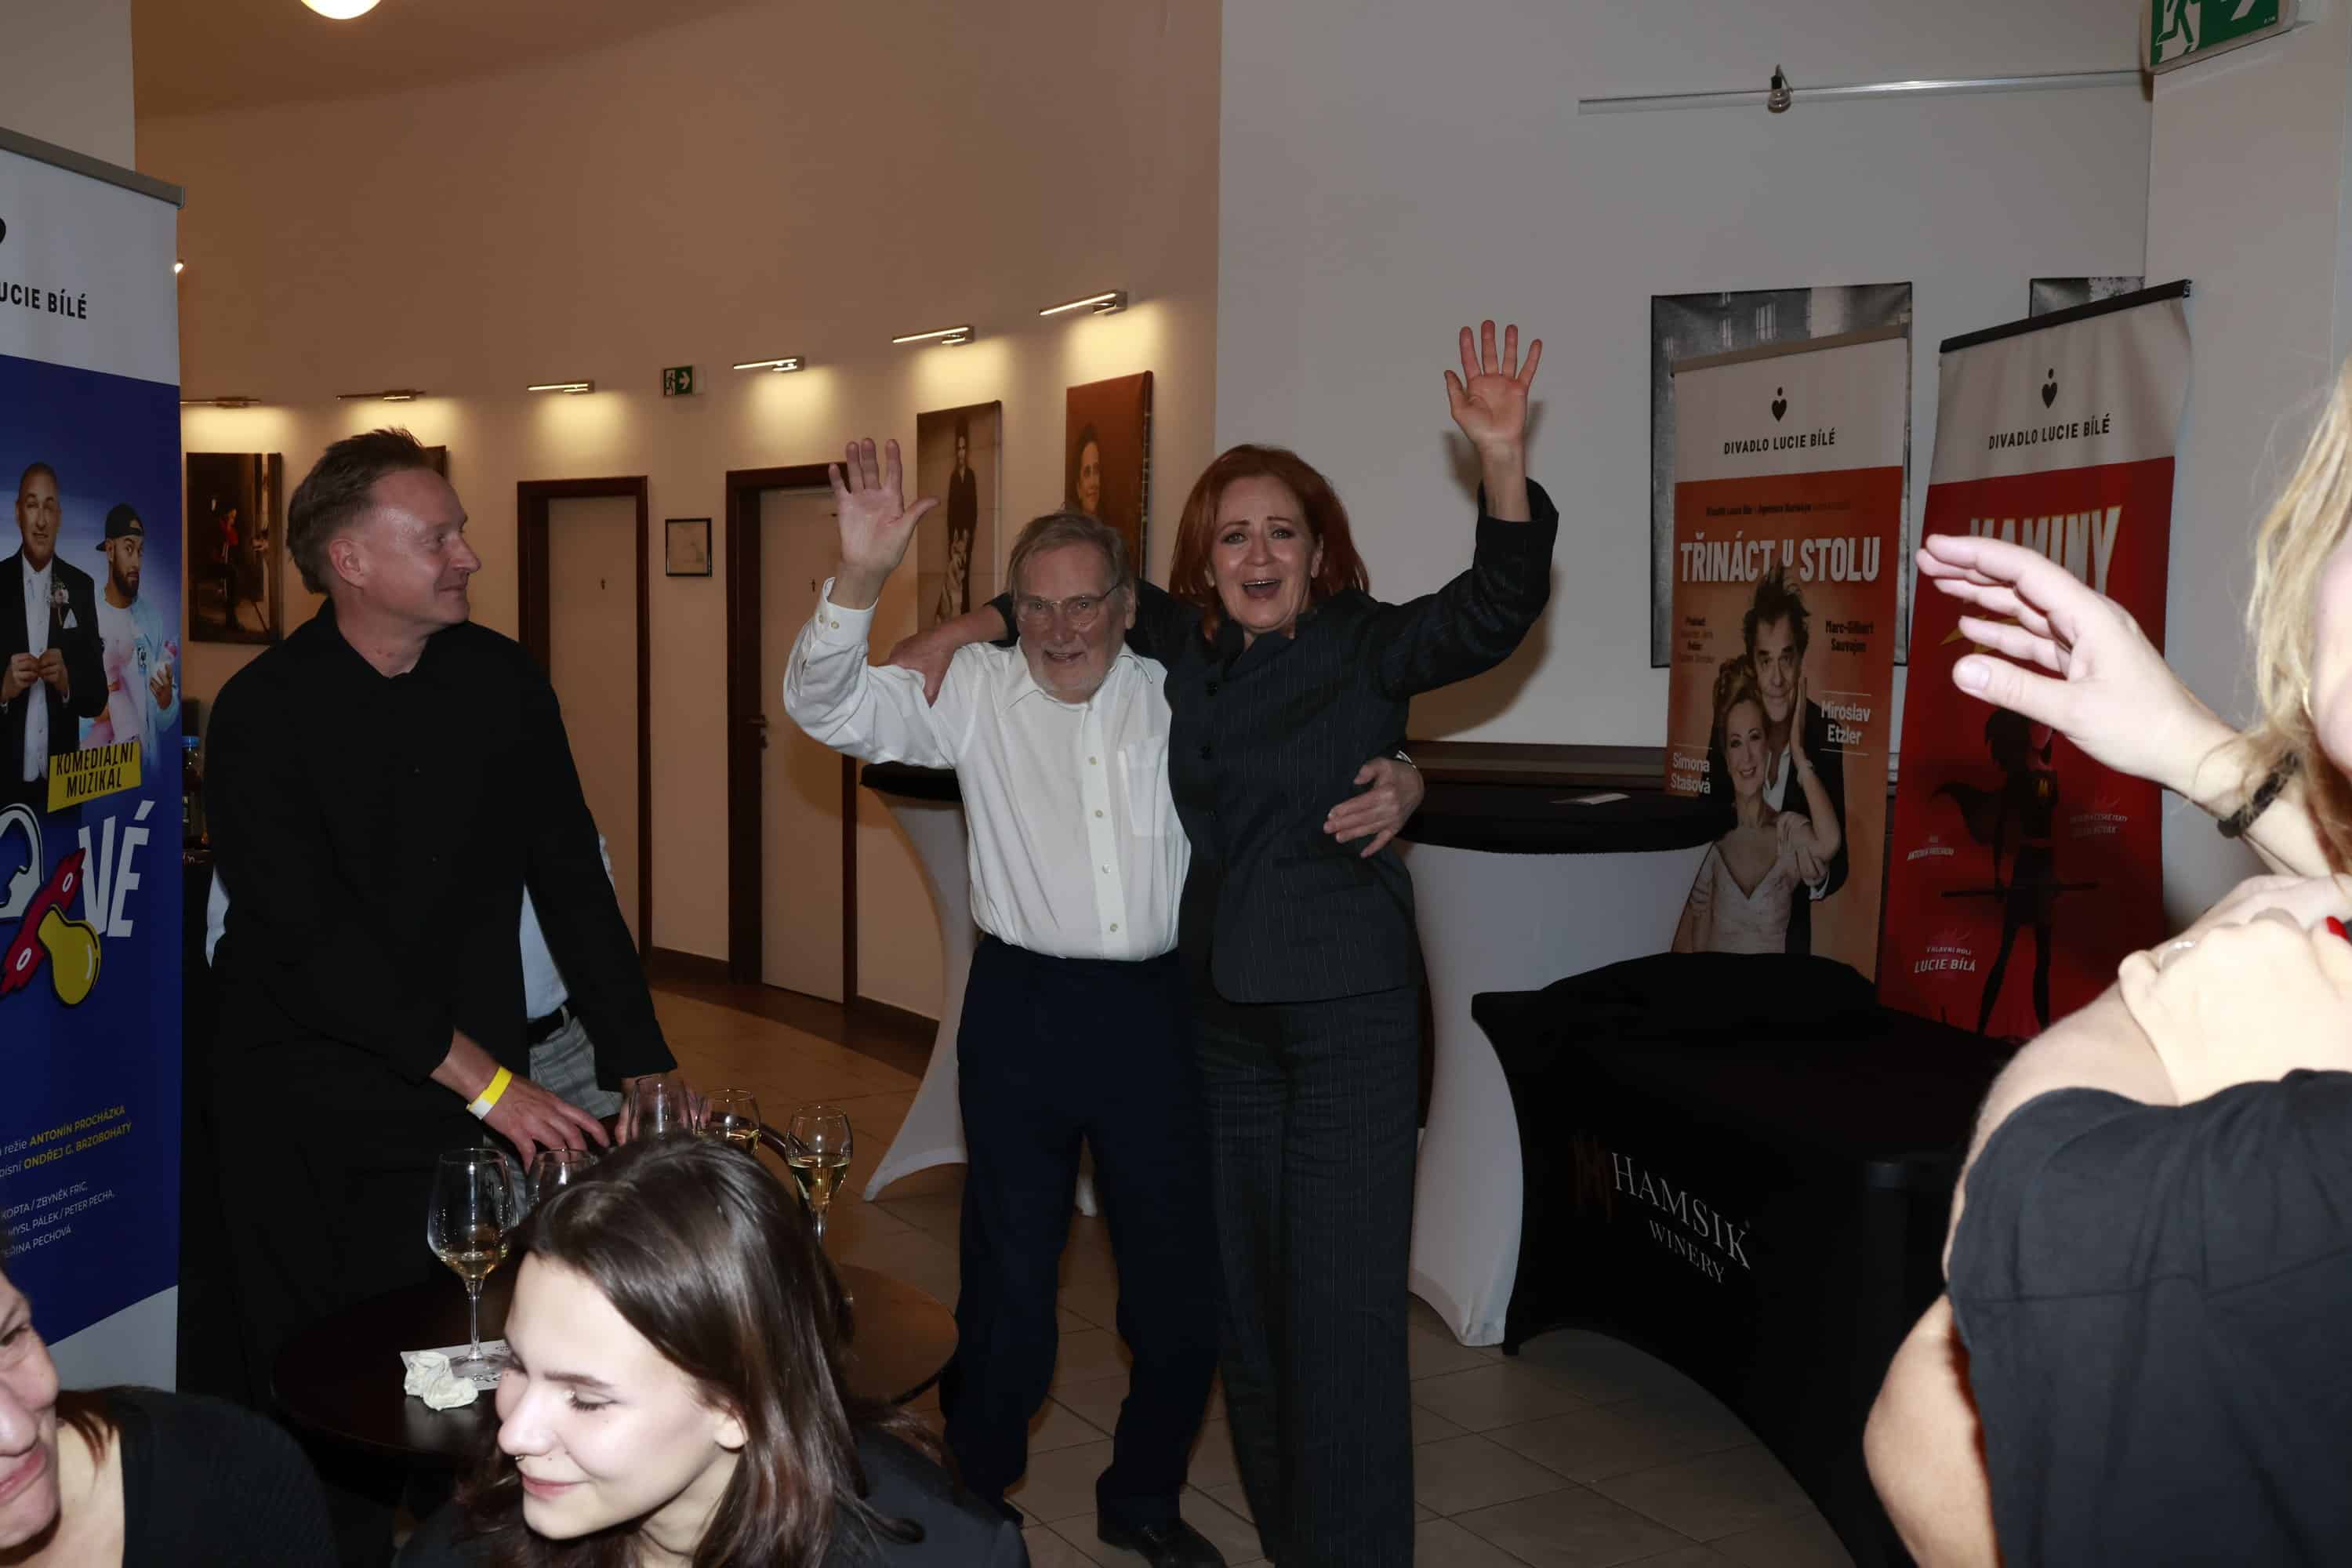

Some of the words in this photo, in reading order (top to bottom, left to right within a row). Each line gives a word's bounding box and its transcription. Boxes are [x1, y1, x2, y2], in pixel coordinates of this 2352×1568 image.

[48, 289, 87, 319] BÍLÉ
[1724, 438, 1769, 455] DIVADLO
[1773, 434, 1806, 451] LUCIE
[1810, 426, 1835, 447] BÍLÉ
[1988, 429, 2038, 450] DIVADLO
[2042, 423, 2078, 442] LUCIE
[2083, 413, 2111, 437] BÍLÉ
[1680, 530, 1776, 582] TŘINÁCT
[1781, 539, 1795, 568] U
[1799, 536, 1882, 582] STOLU
[1821, 701, 1871, 722] Miroslav
[1827, 724, 1863, 745] Etzler
[56, 735, 137, 776] KOMEDIÁLNÍ
[1673, 751, 1711, 772] Simona
[1670, 773, 1711, 794] Stašová
[1914, 959, 1948, 974] LUCIE
[1950, 956, 1976, 972] BÍLÁ
[4, 1140, 27, 1155] režie
[30, 1123, 73, 1146] ANTONÍN
[74, 1105, 125, 1131] PROCHÁZKA
[24, 1146, 64, 1169] ONDŘEJ
[64, 1199, 88, 1218] PETER
[1612, 1152, 1751, 1271] HAMSIK
[32, 1223, 71, 1248] PECHOVÁ
[1650, 1219, 1725, 1283] WINERY
